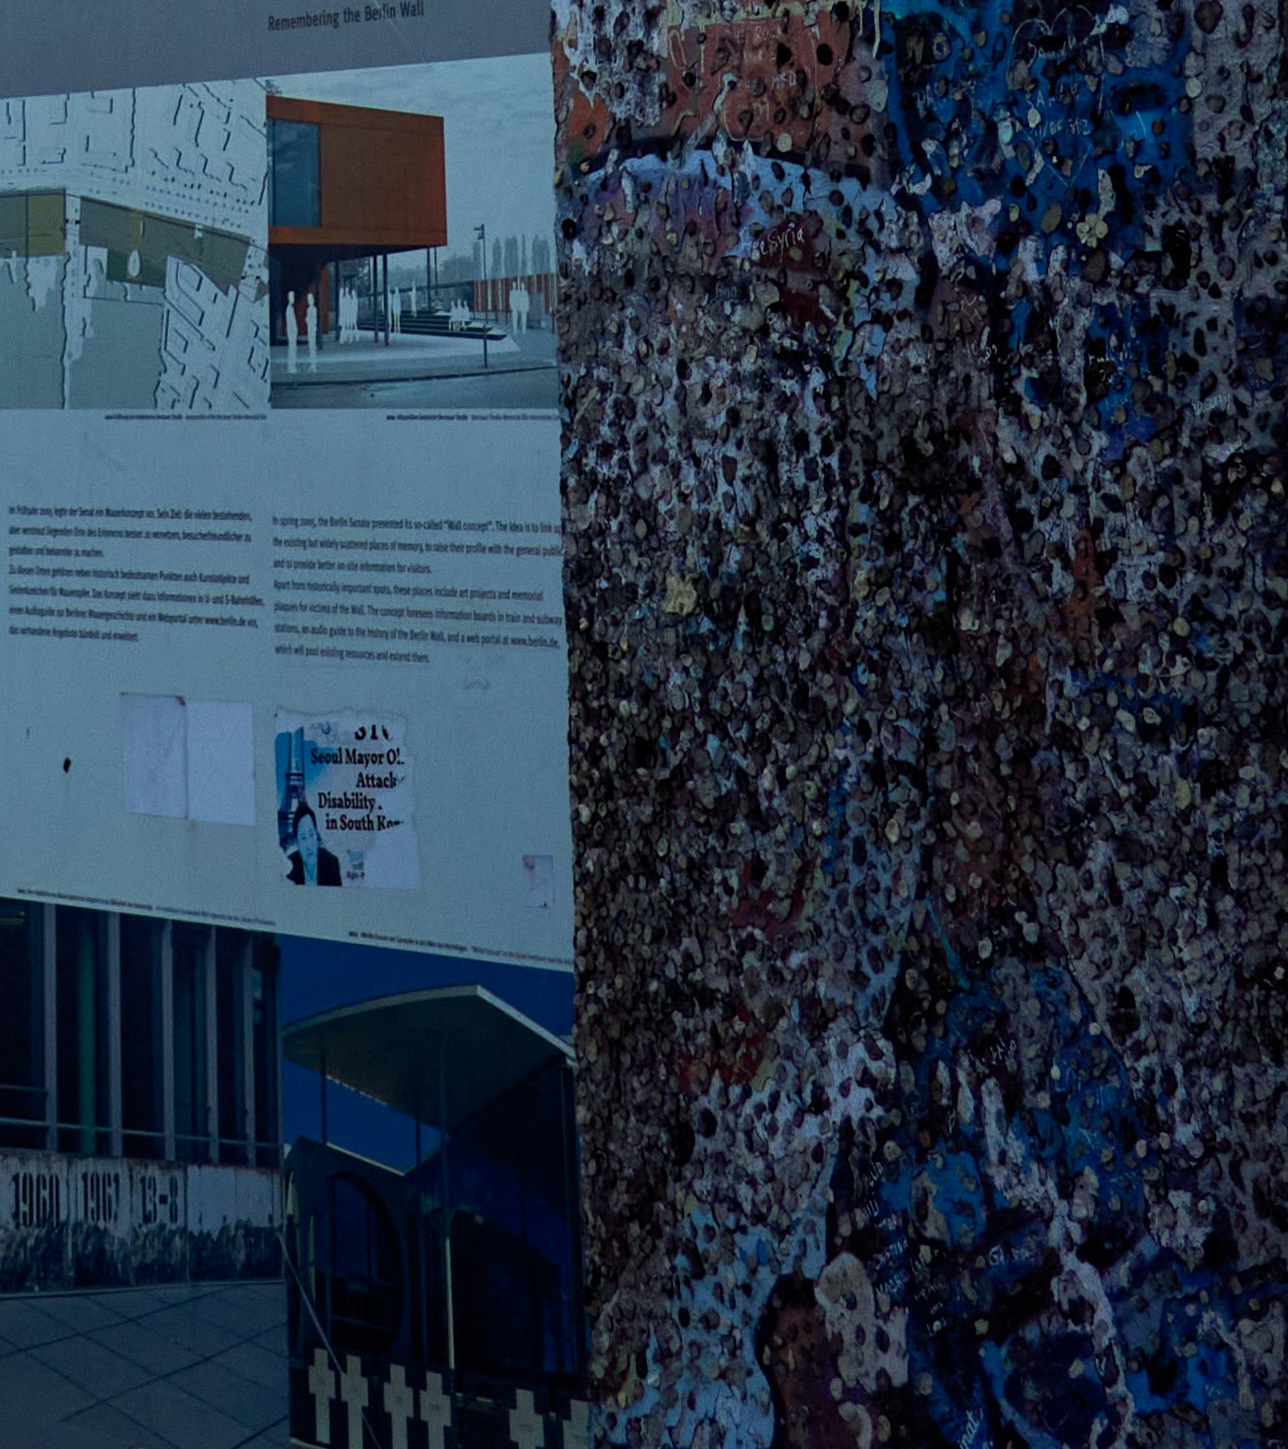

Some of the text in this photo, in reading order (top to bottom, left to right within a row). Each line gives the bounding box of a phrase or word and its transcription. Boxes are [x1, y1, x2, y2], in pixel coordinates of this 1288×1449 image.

[267, 9, 340, 31] Remembering
[343, 6, 360, 22] the
[364, 2, 397, 22] Berlin
[310, 748, 343, 765] Seoul
[344, 749, 384, 768] Mayor
[317, 793, 376, 814] Disability
[325, 813, 338, 830] in
[339, 813, 374, 831] South
[11, 1170, 62, 1228] 1960
